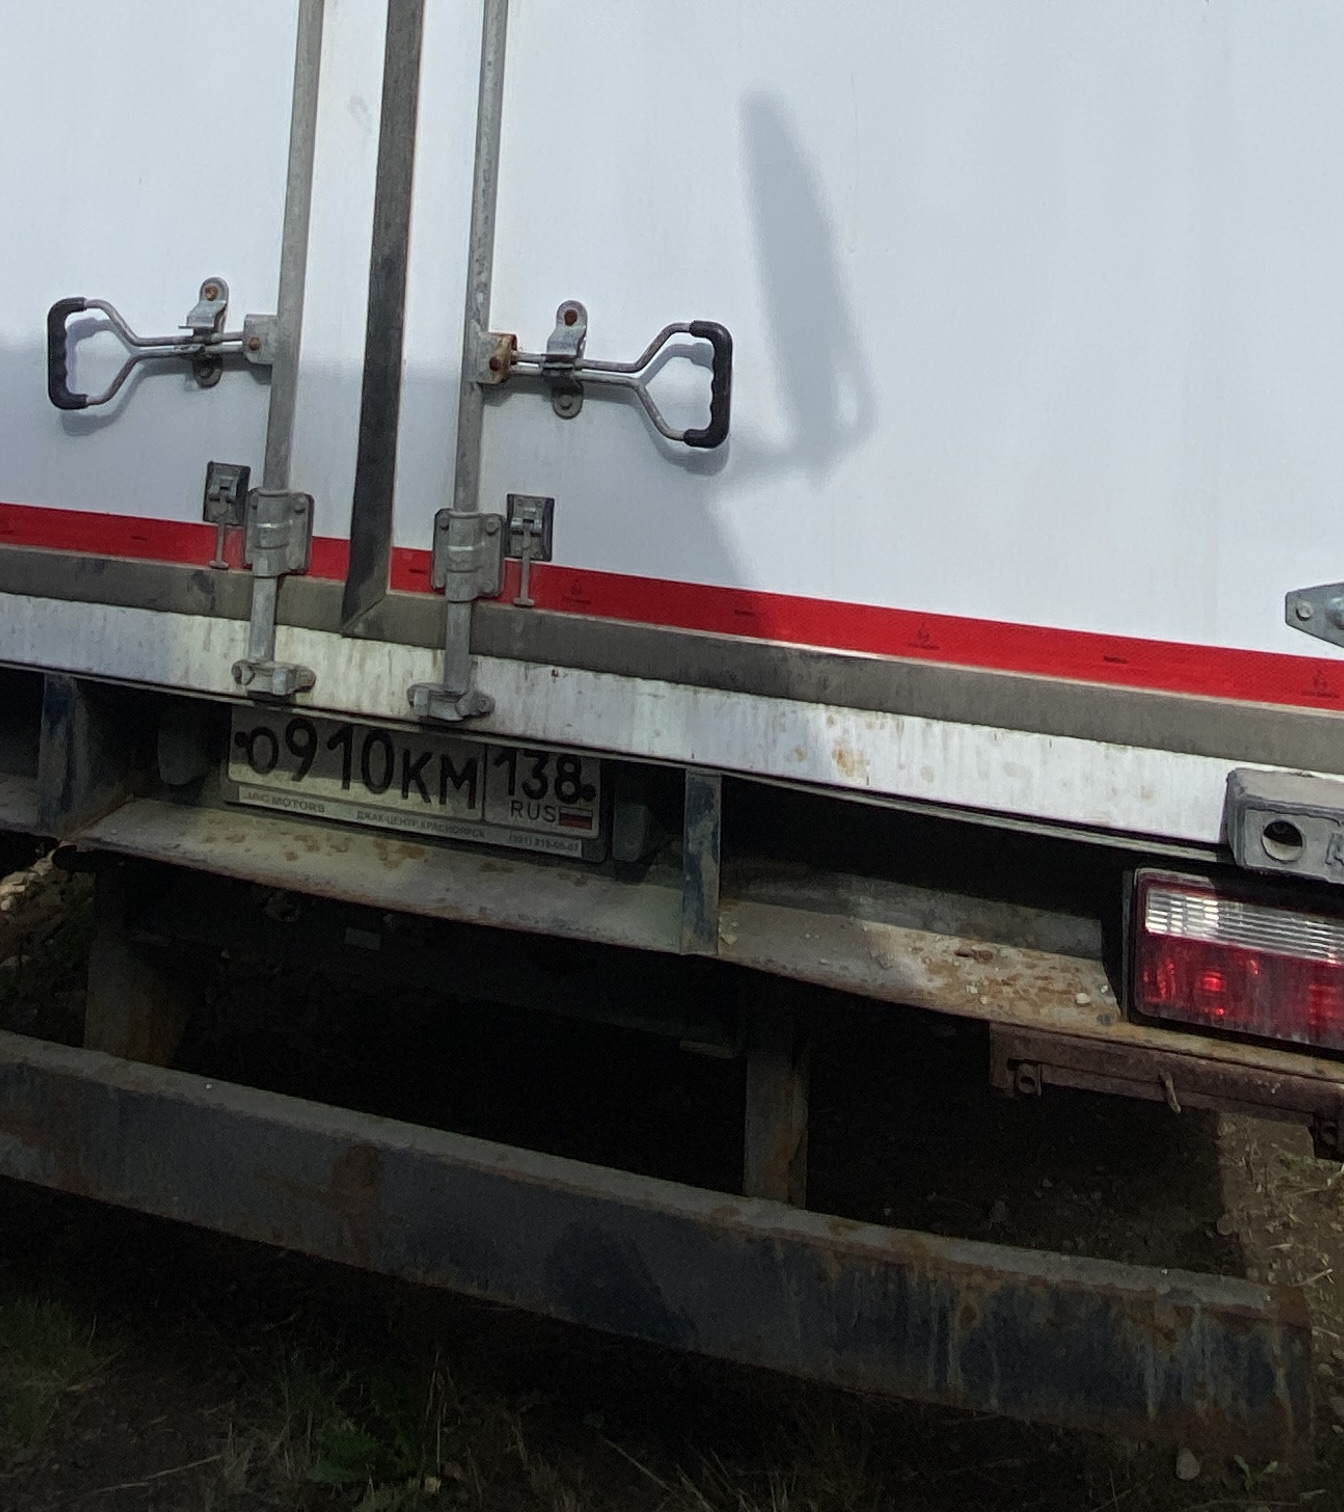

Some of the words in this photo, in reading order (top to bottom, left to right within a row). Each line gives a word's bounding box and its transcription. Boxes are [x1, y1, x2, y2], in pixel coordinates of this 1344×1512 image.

[493, 748, 585, 806] 138
[271, 796, 326, 814] MOTORS
[510, 800, 556, 824] RUS
